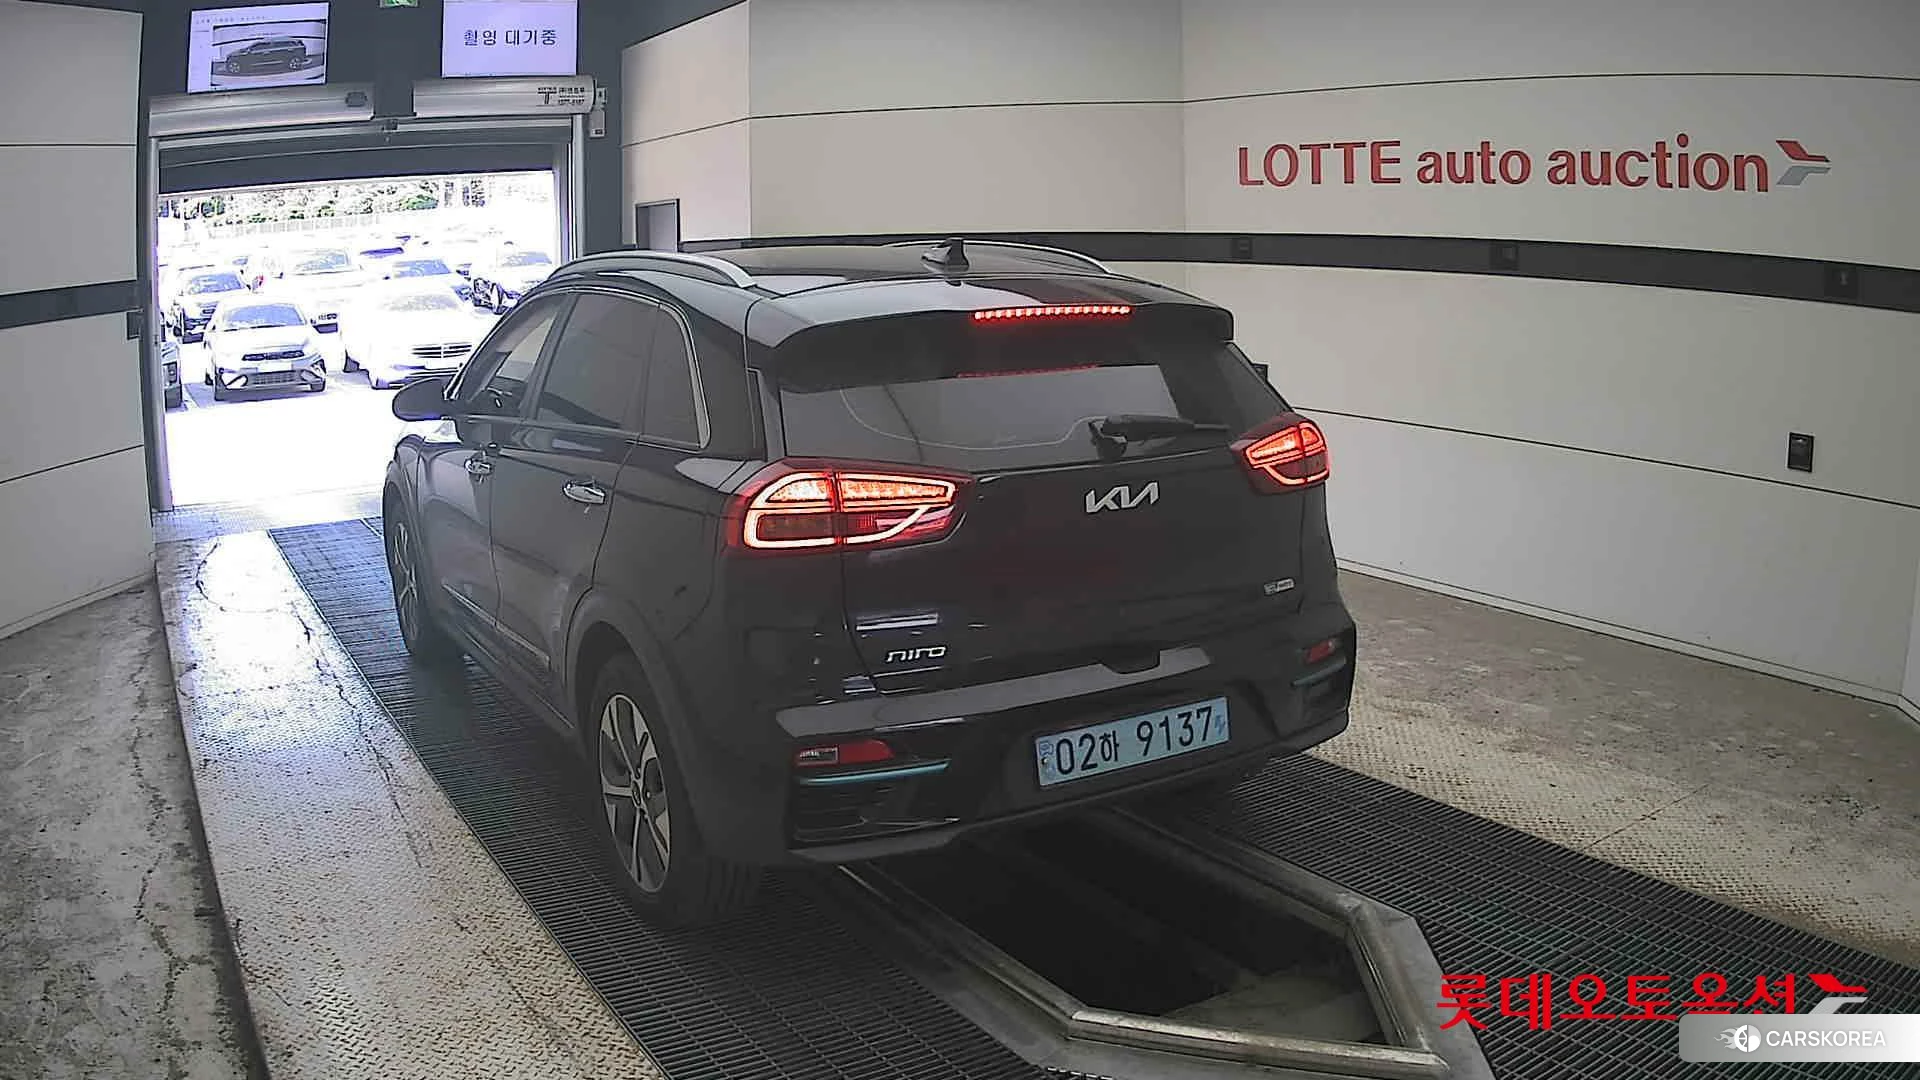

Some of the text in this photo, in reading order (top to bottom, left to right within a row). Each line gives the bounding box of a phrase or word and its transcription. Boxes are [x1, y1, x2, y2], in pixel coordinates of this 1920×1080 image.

[505, 29, 557, 46] 대기중
[1238, 133, 1769, 192] LOTTE auto auction
[1085, 481, 1159, 513] KIA
[886, 646, 946, 662] niro
[1056, 706, 1213, 775] 02하 9137
